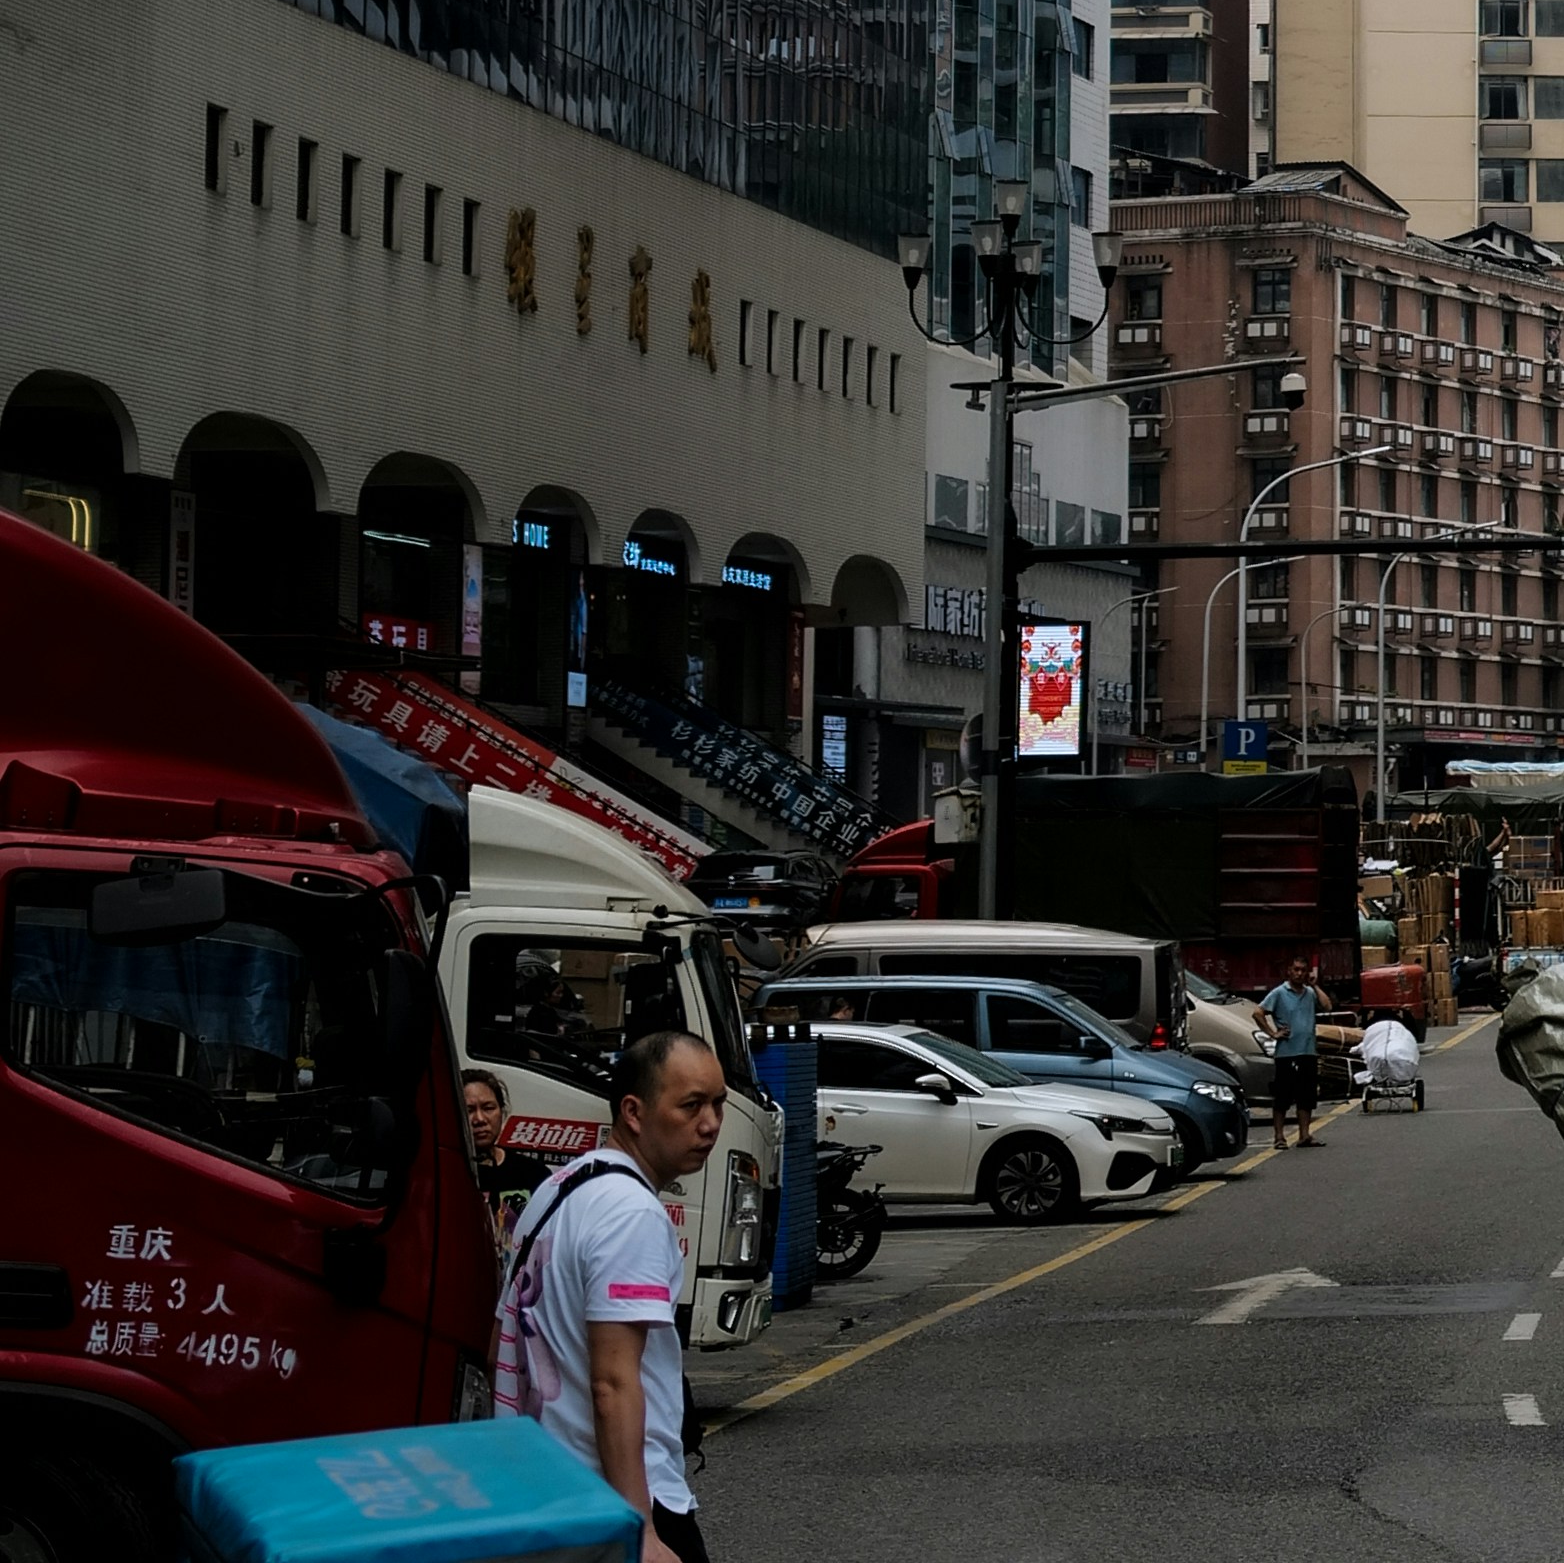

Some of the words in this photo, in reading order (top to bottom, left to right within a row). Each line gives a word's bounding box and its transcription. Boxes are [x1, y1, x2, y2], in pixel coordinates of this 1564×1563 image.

[670, 720, 761, 785] 杉杉家纺
[1237, 727, 1257, 756] P
[507, 1120, 586, 1151] 货拉拉
[105, 1224, 174, 1261] 重庆
